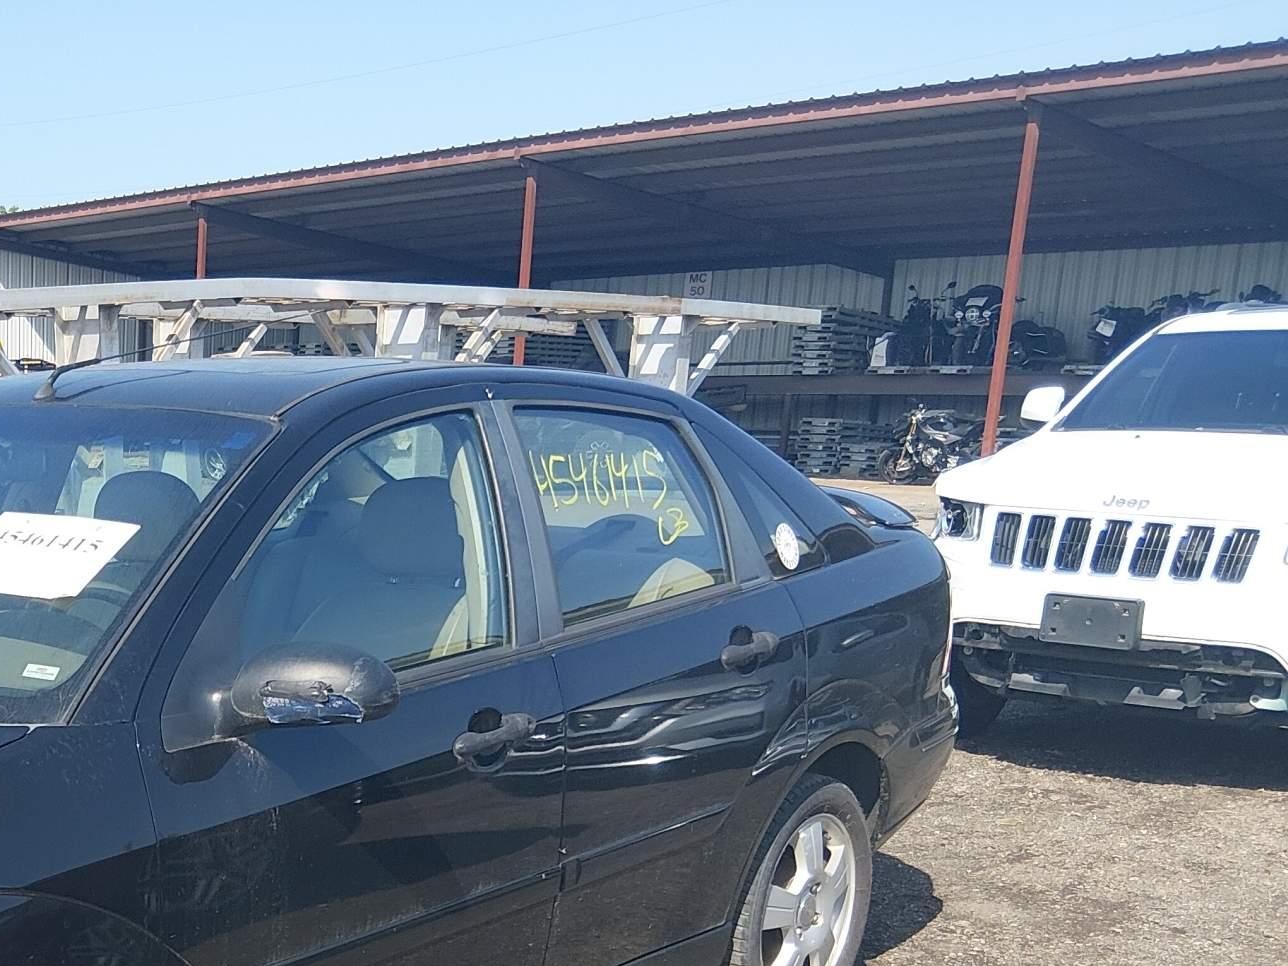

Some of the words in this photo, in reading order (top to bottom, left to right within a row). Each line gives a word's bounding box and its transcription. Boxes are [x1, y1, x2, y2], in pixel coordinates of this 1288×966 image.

[689, 273, 707, 283] MC
[689, 286, 705, 297] 50
[528, 447, 668, 511] 45461415
[1104, 495, 1149, 510] Jeep
